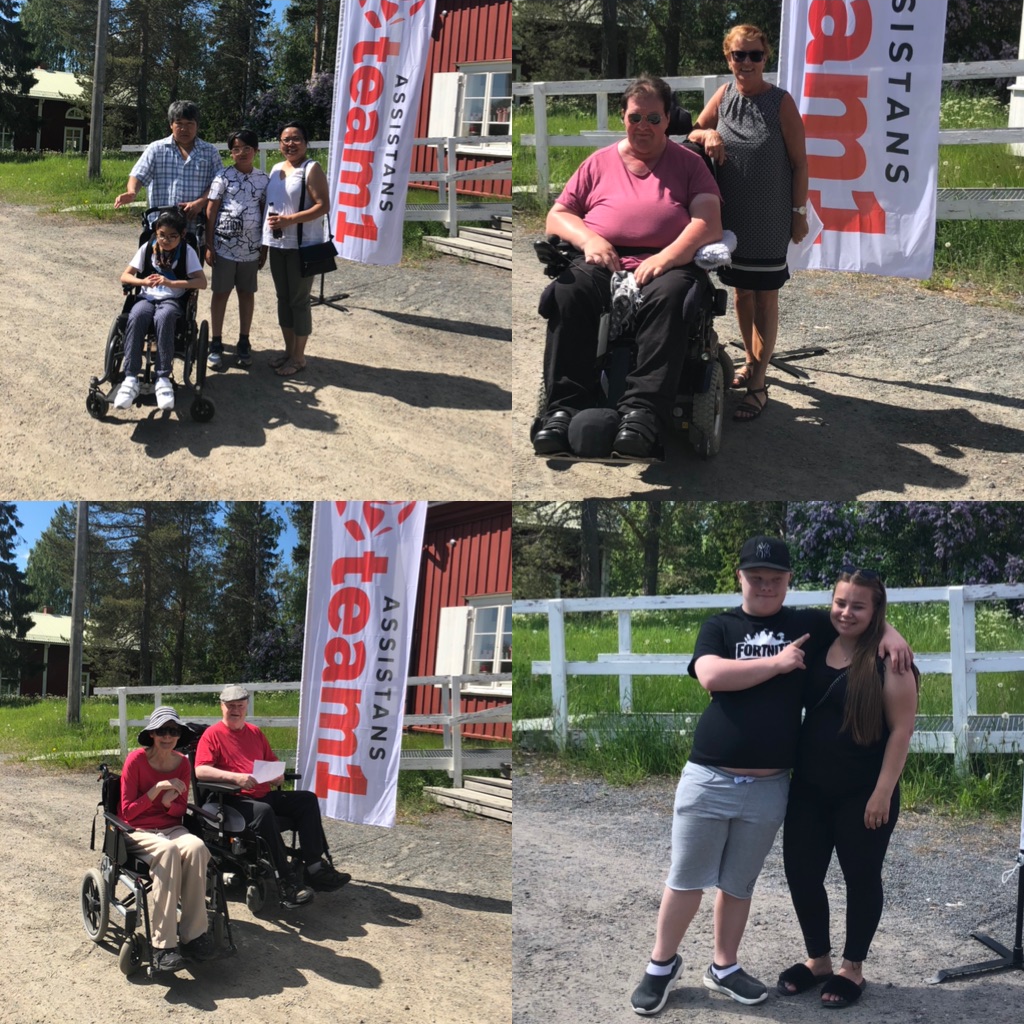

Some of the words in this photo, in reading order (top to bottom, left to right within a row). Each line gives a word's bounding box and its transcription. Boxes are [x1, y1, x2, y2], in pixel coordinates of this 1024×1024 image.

[335, 36, 401, 244] team1
[379, 74, 409, 212] ASSISTANS
[315, 550, 389, 799] team1
[370, 595, 401, 761] ASSISTANS
